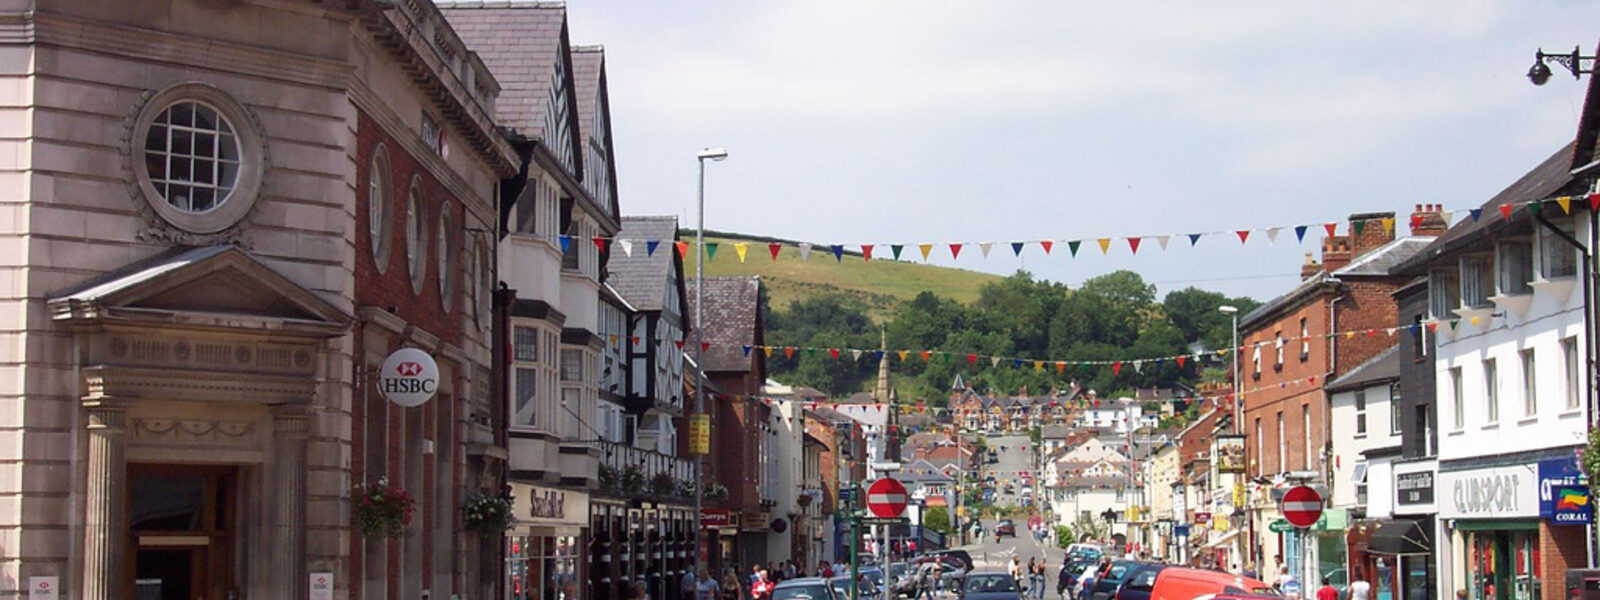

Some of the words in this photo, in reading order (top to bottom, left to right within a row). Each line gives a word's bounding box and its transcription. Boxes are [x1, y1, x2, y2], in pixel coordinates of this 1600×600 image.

[385, 378, 436, 394] HSBC
[1454, 474, 1519, 513] CLUBSPORT
[1556, 513, 1588, 521] CORAL
